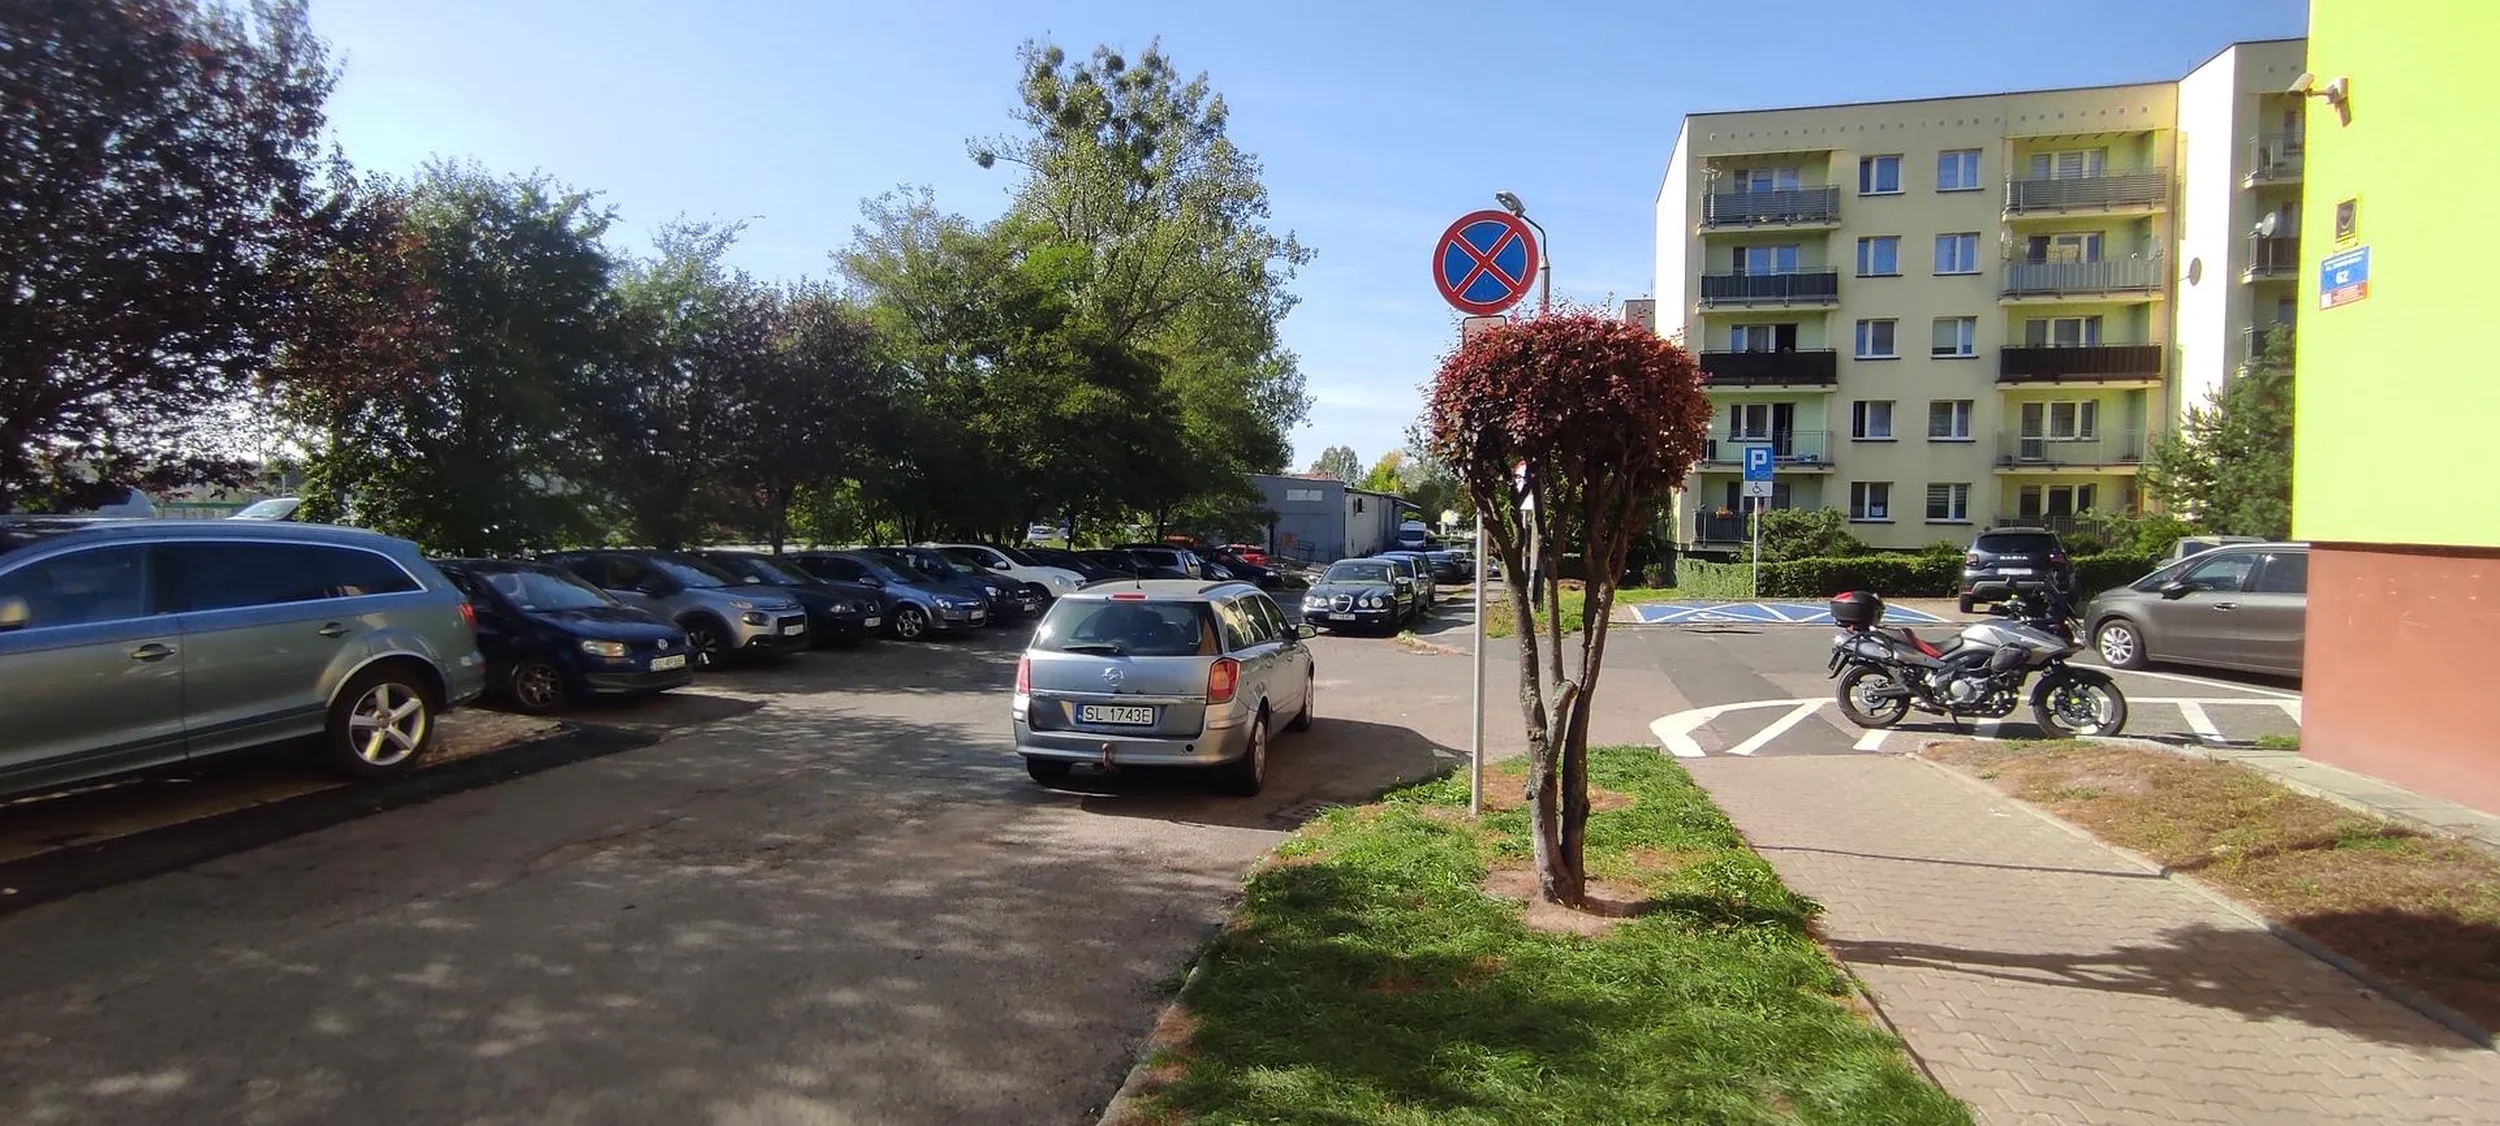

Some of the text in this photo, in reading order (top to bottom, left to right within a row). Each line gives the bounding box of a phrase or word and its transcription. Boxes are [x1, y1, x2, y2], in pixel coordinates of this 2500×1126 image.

[1751, 450, 1767, 470] P
[1085, 706, 1151, 723] SL 1743E
